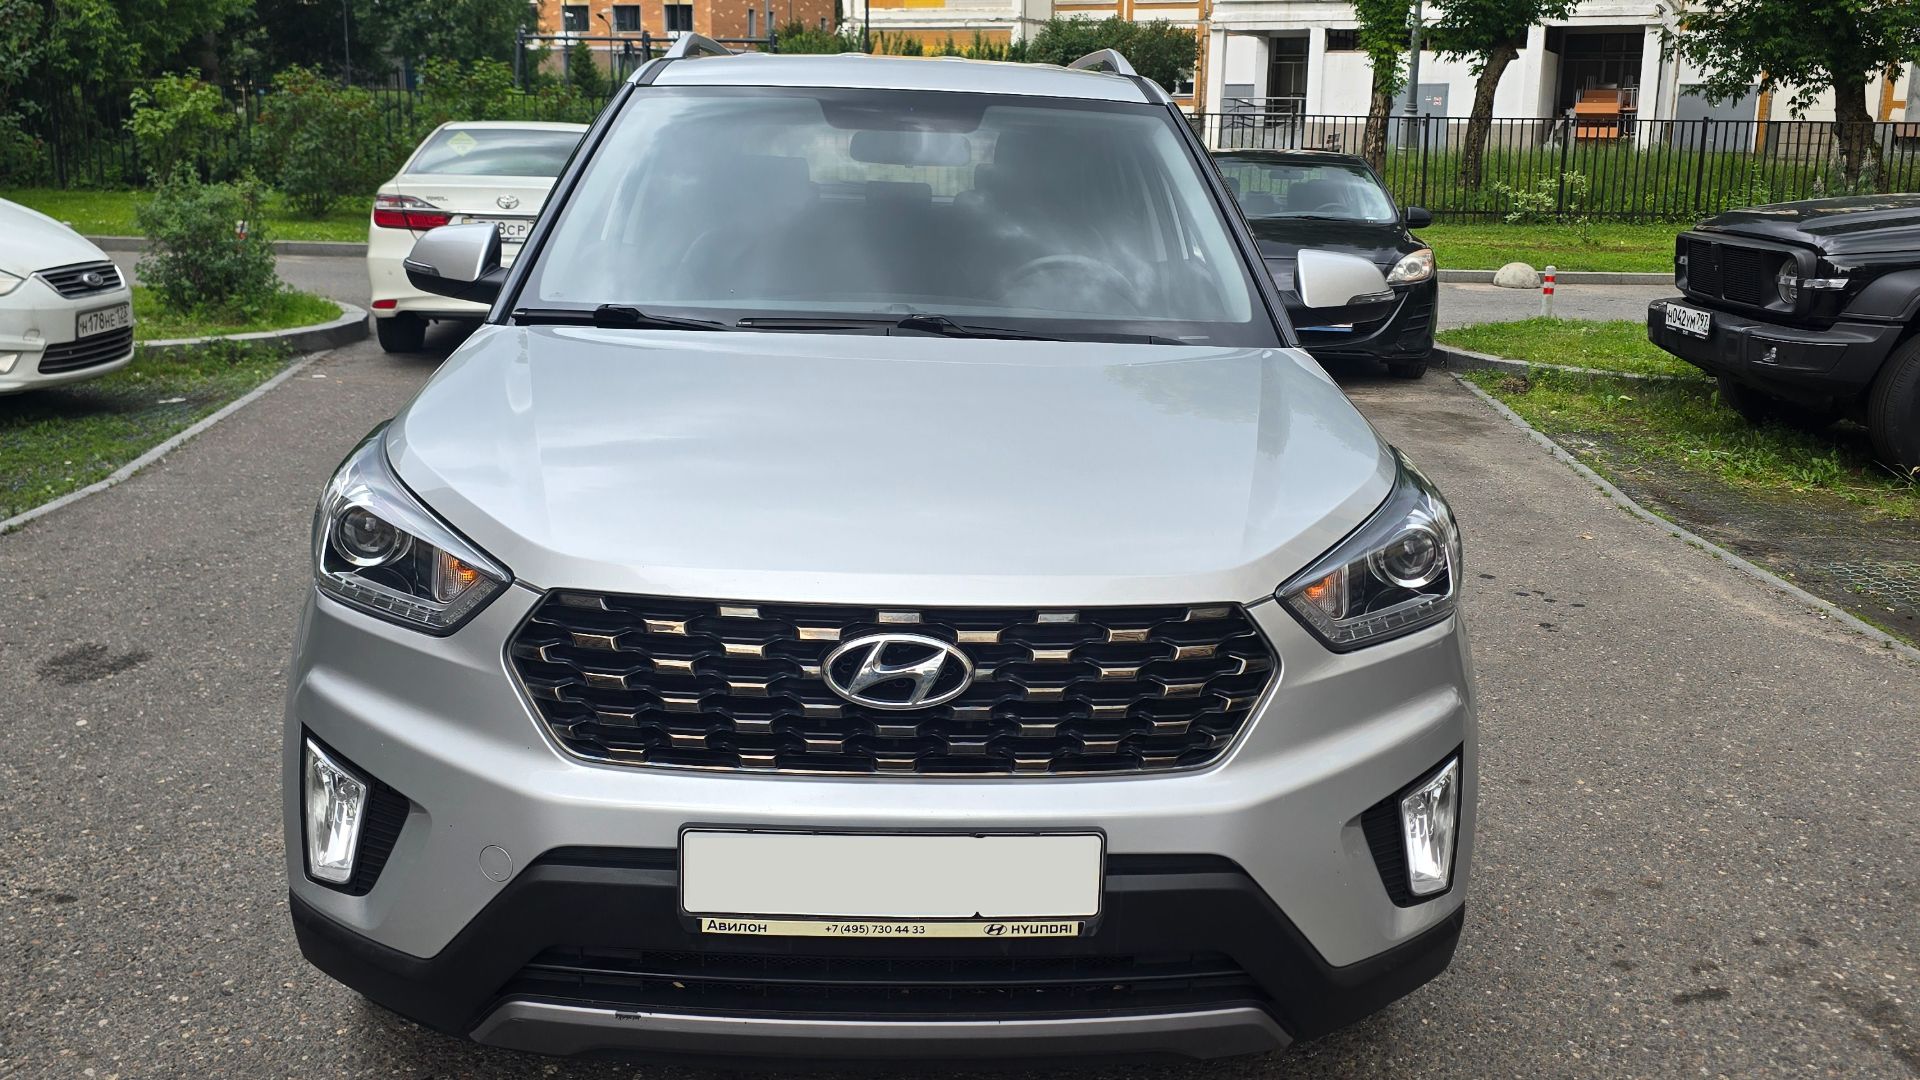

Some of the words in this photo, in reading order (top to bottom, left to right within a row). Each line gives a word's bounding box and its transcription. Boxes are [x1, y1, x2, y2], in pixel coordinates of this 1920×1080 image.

[1667, 307, 1696, 330] Н042УМ
[1696, 313, 1708, 328] 797
[706, 919, 768, 933] Авилон
[825, 924, 838, 933] +7
[840, 924, 869, 935] (495)
[872, 925, 892, 934] 730
[894, 925, 909, 934] 44
[912, 925, 926, 934] 33
[1011, 924, 1072, 934] HYUNDAI
